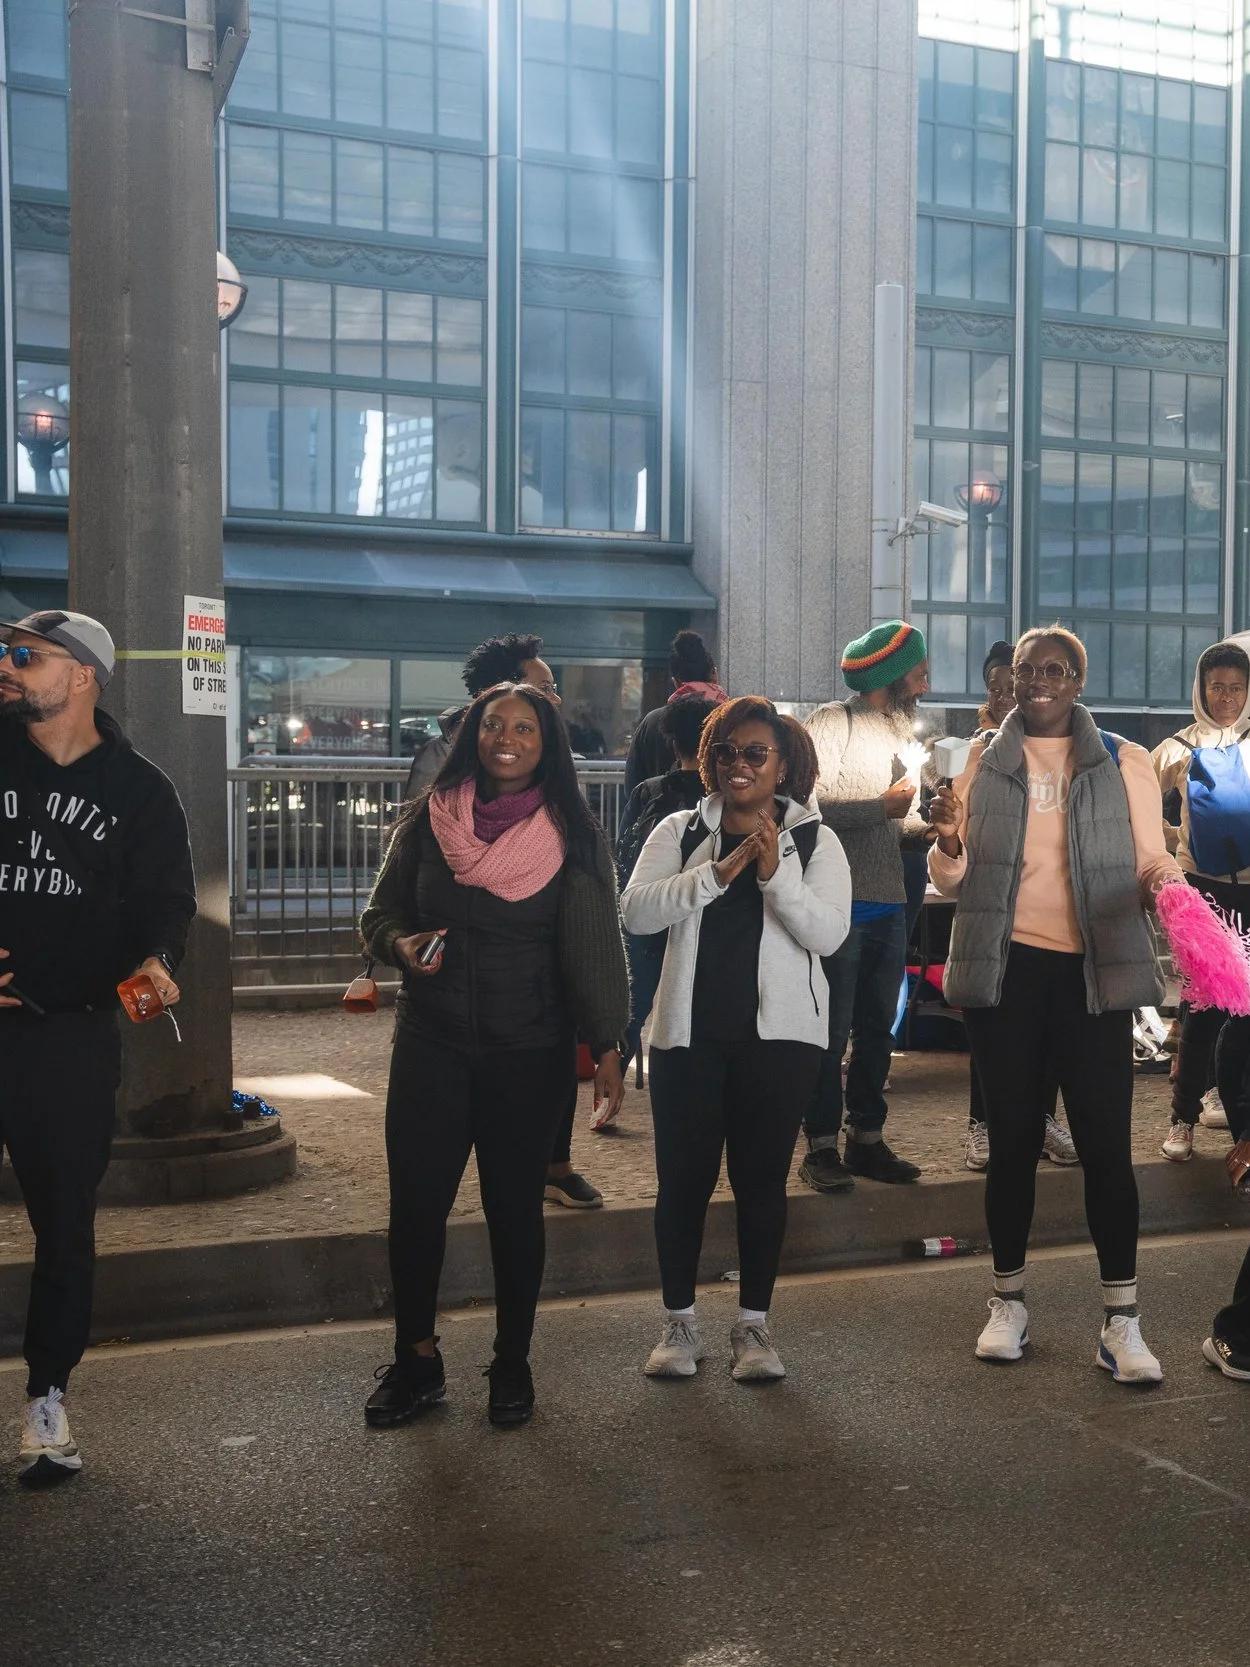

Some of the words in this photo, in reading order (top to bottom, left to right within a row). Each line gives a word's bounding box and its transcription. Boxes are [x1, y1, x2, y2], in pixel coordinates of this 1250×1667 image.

[188, 615, 225, 634] EMERGE
[187, 635, 202, 651] NO
[205, 637, 226, 655] PARK
[187, 657, 200, 672] ON
[203, 658, 222, 674] THIS
[193, 676, 204, 691] OF
[207, 678, 226, 693] STRE
